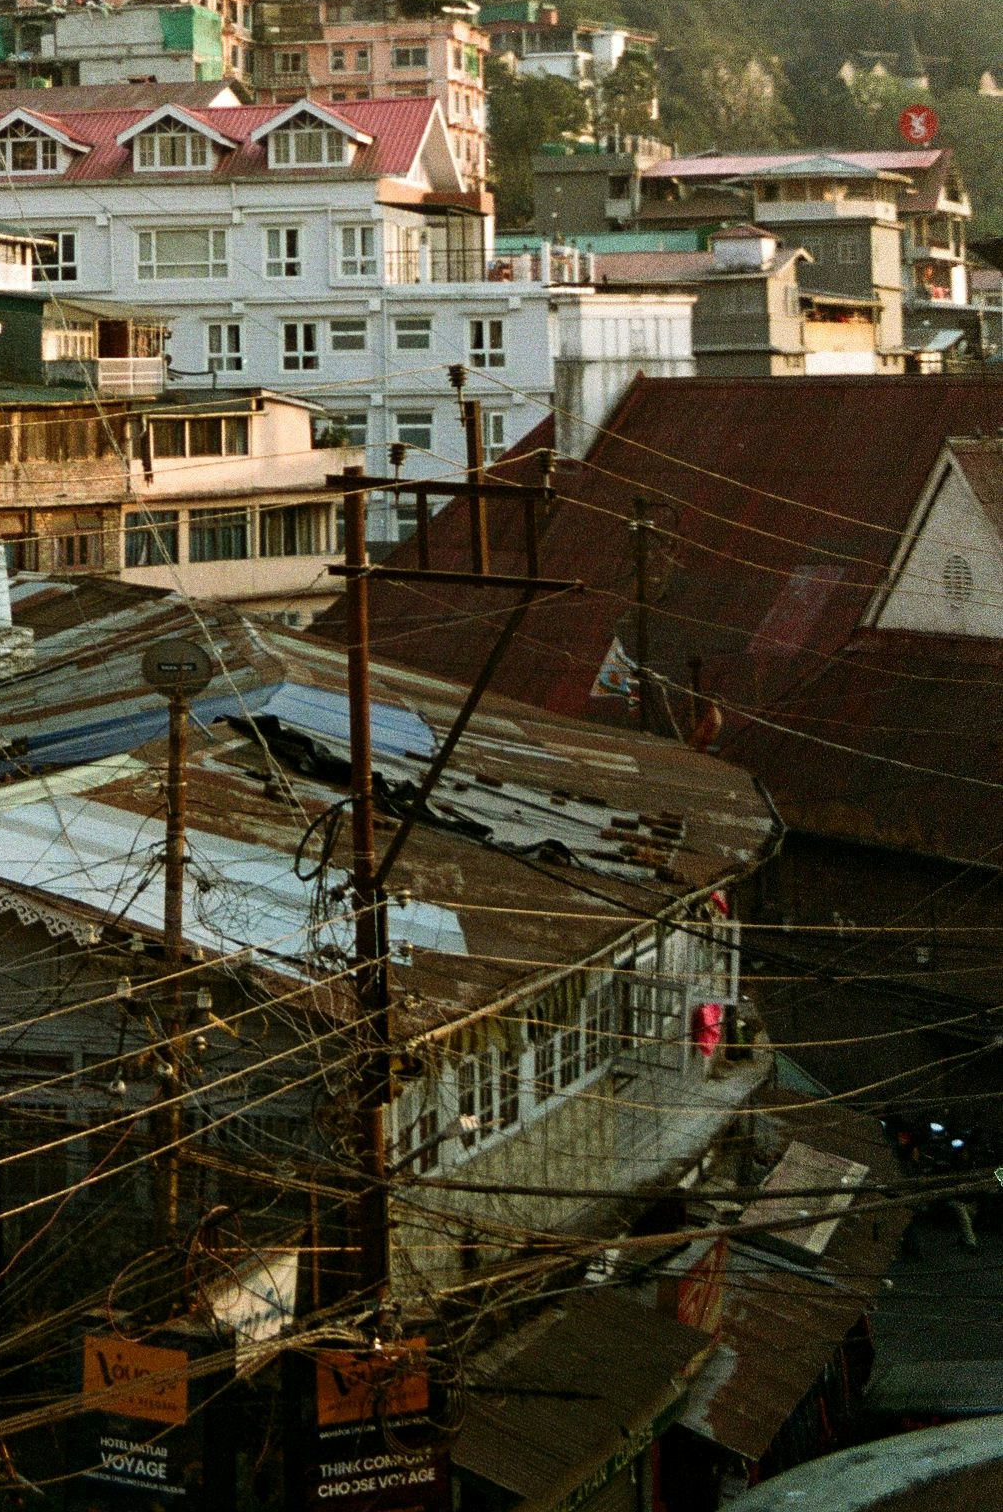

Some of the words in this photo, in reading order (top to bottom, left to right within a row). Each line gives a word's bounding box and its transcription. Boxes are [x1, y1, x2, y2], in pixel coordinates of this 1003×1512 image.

[100, 1436, 129, 1450] HOTEL
[101, 1451, 167, 1479] VOYAGE
[319, 1457, 362, 1479] THINK
[318, 1477, 377, 1498] CHOOSE
[378, 1467, 436, 1489] VOYAGE
